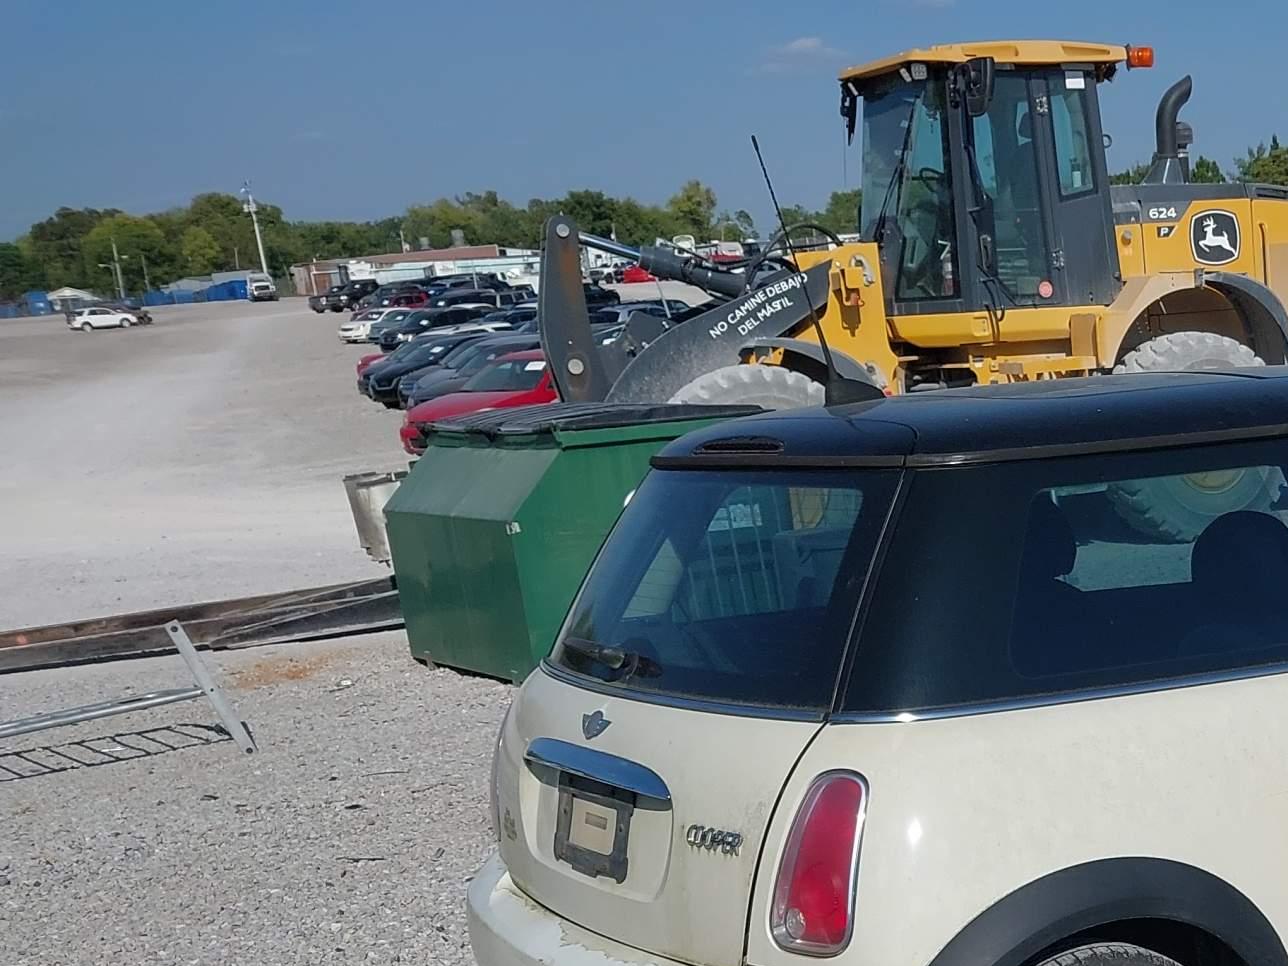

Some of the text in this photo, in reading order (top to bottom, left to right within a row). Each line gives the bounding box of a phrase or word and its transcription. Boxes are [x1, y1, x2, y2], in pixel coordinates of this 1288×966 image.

[1149, 207, 1177, 219] 624
[1160, 226, 1169, 237] P
[708, 272, 808, 339] NO CAMINE DEBAJO
[737, 317, 761, 336] DEL
[686, 824, 744, 857] COOPER
